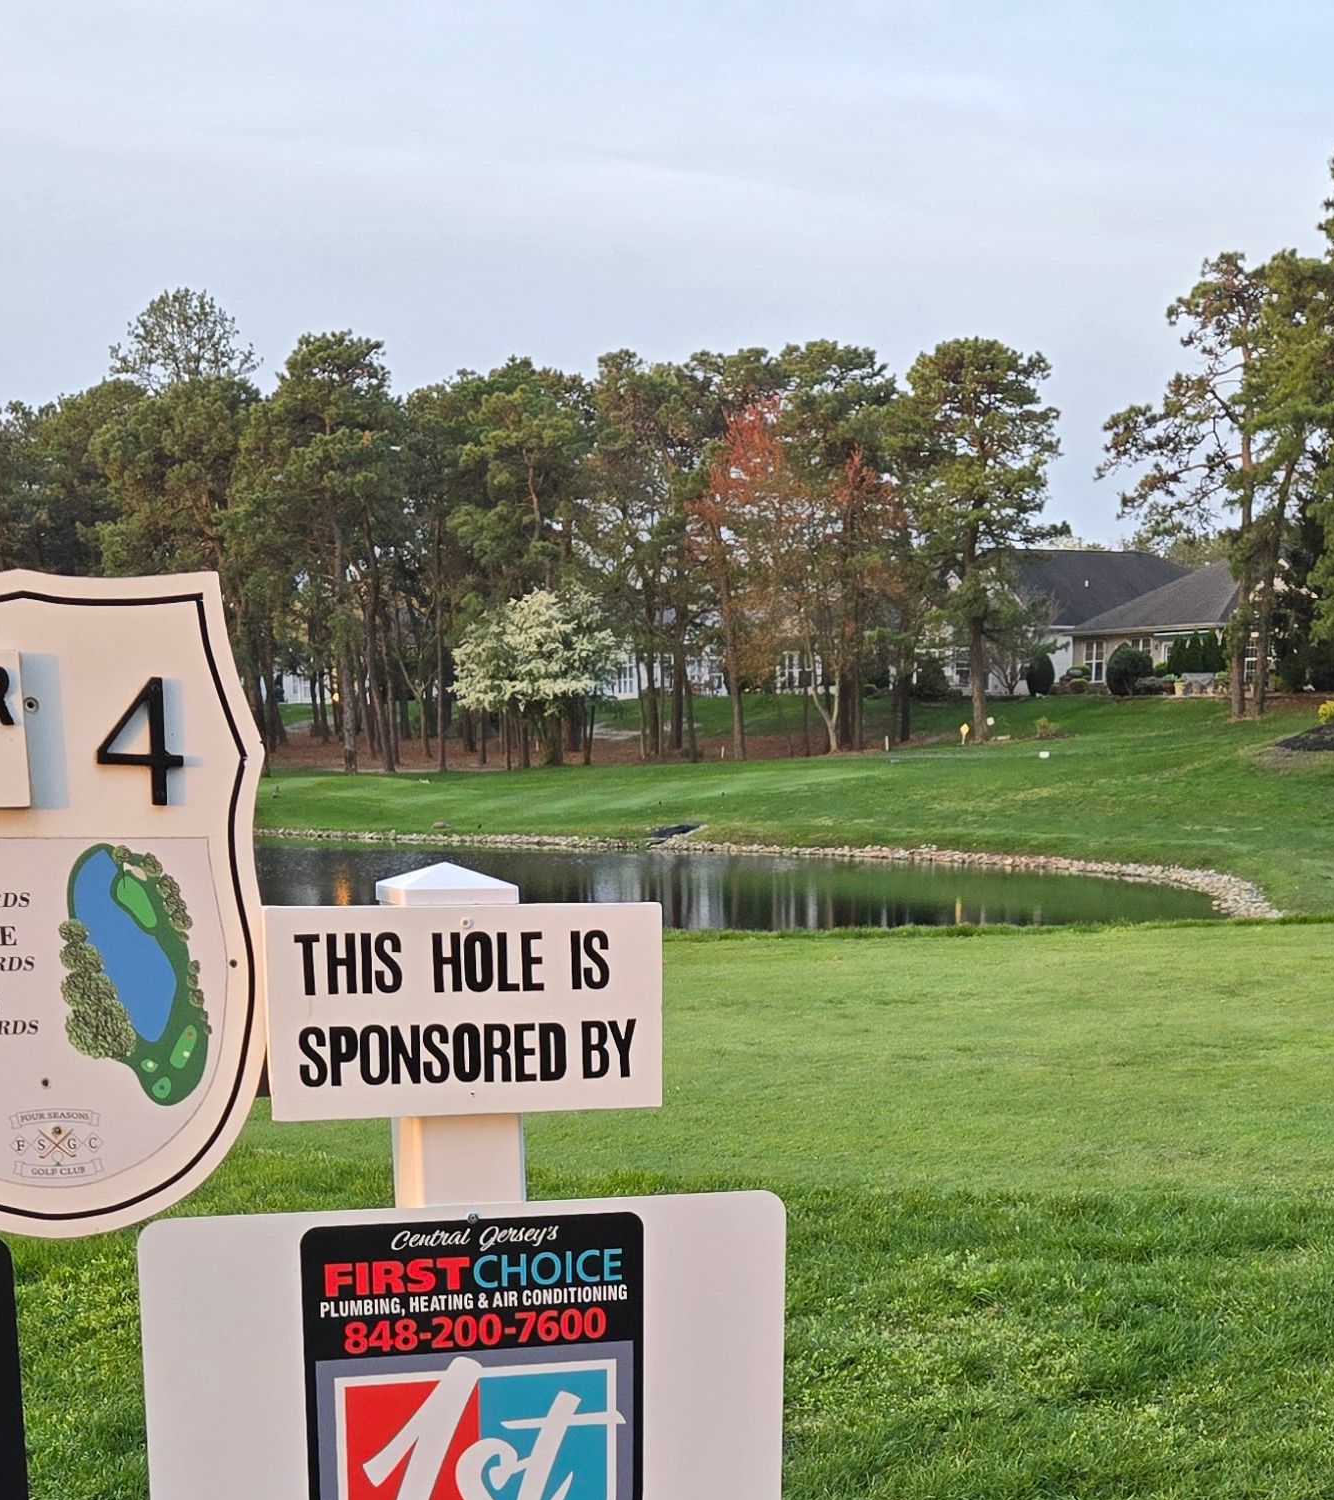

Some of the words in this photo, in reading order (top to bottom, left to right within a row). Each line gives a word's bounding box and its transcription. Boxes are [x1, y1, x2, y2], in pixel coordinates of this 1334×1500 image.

[96, 676, 184, 806] 4
[294, 932, 402, 995] THIS
[432, 931, 544, 993] HOLE
[570, 930, 610, 990] IS
[298, 1022, 567, 1087] SPONSORED
[581, 1018, 636, 1079] BY
[21, 1113, 46, 1122] FOUR
[48, 1112, 89, 1120] SEASONS
[60, 1166, 85, 1175] CLUB
[391, 1228, 470, 1250] Central
[479, 1225, 559, 1250] Jersey's
[324, 1256, 471, 1297] FIRST
[473, 1248, 623, 1289] CHOICE
[320, 1297, 406, 1318] PLUMBING,
[409, 1293, 474, 1313] HEATING
[478, 1292, 489, 1308] &
[492, 1290, 518, 1307] AIR
[522, 1284, 628, 1306] CONDITIONING
[343, 1306, 606, 1354] 848-200-7600
